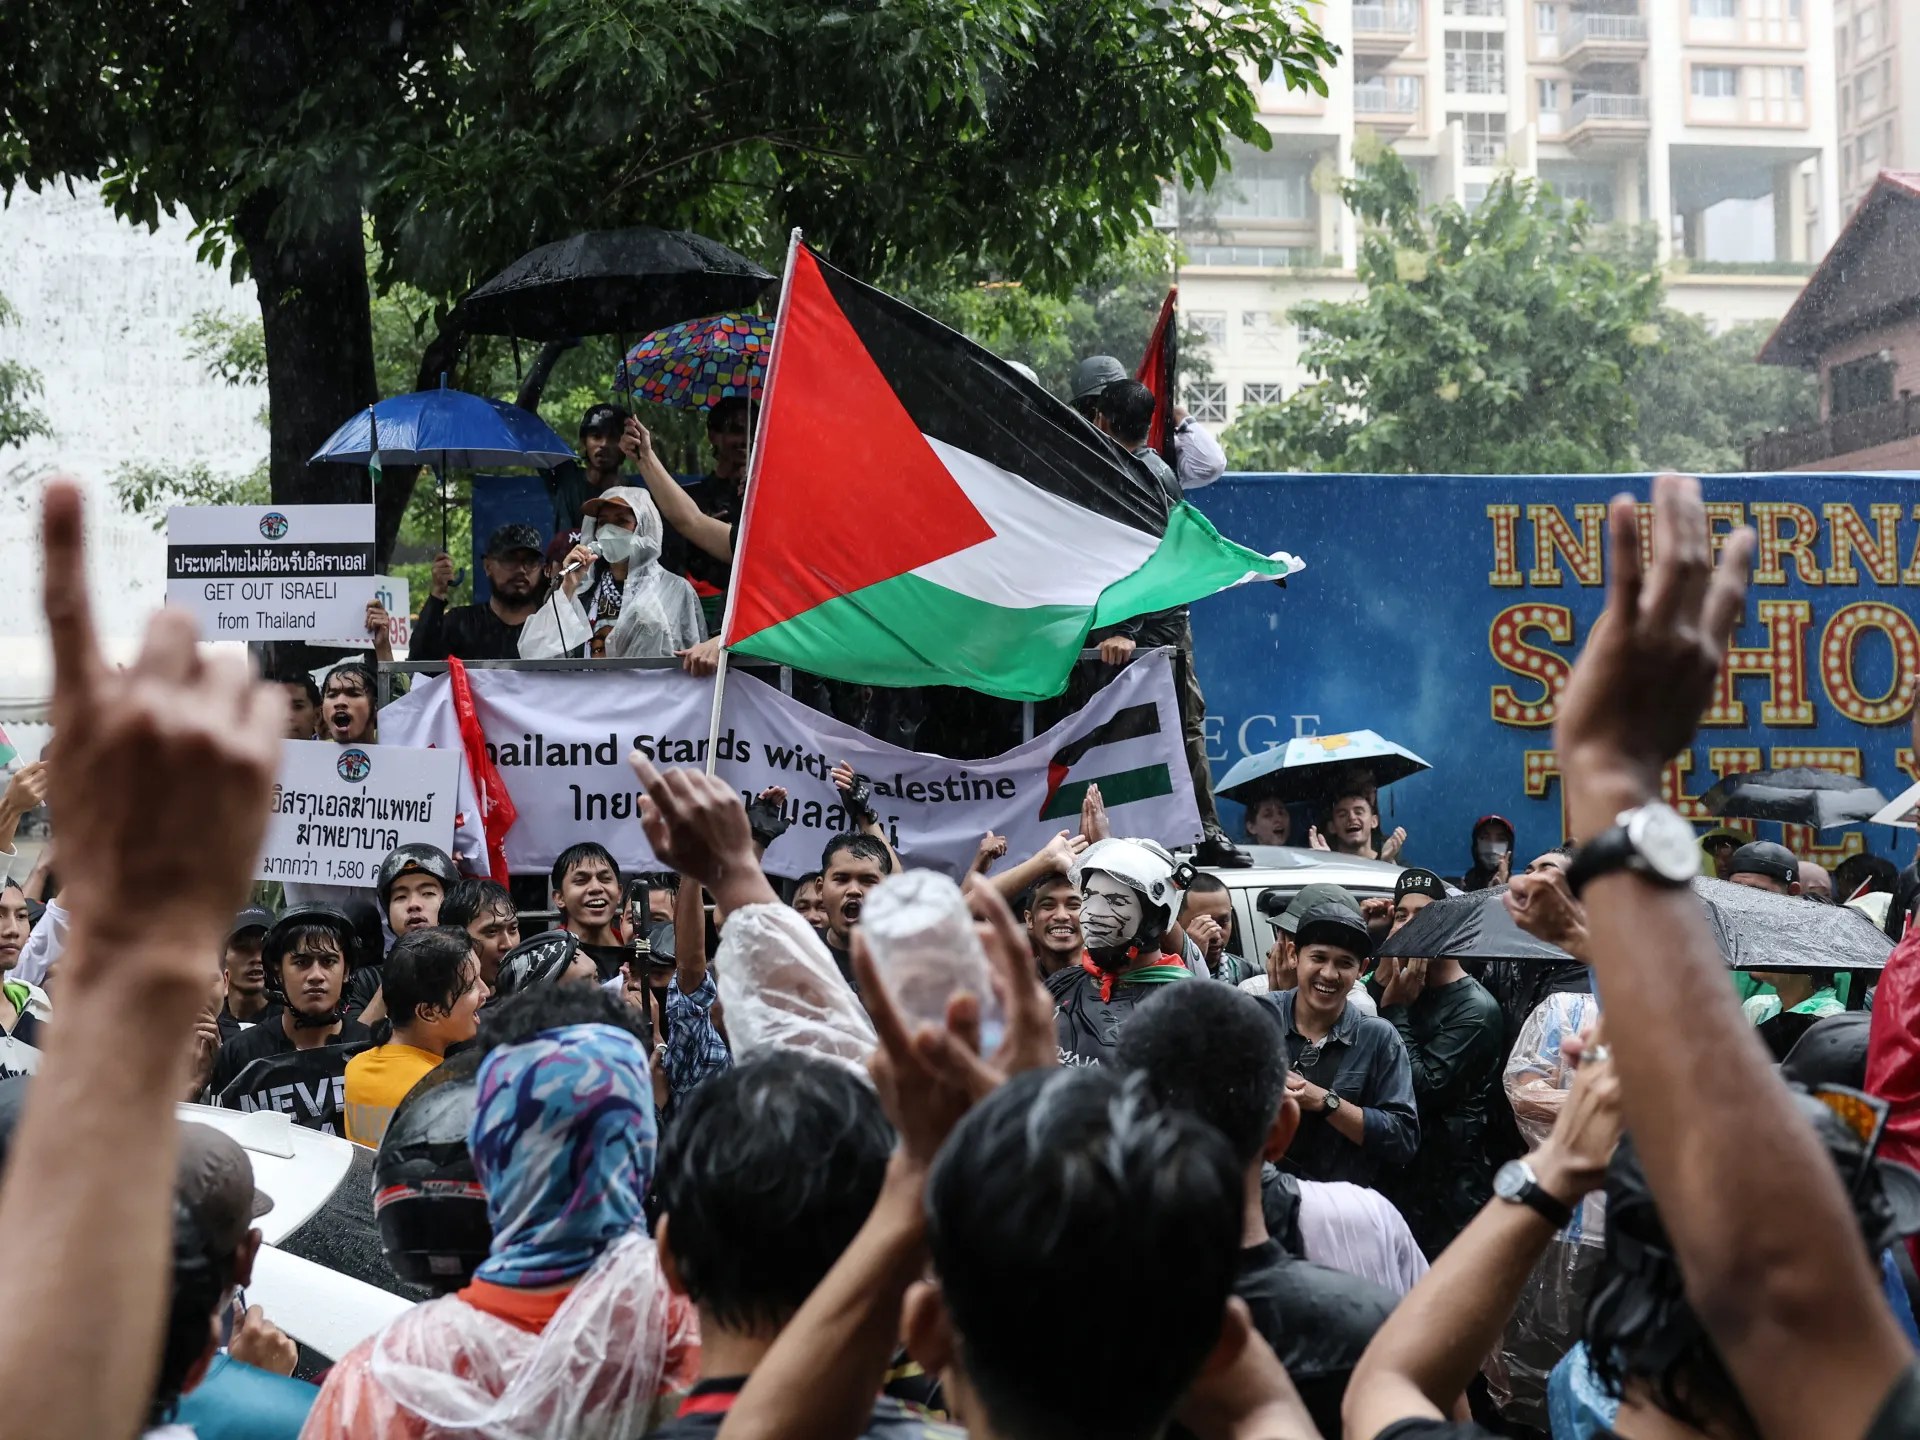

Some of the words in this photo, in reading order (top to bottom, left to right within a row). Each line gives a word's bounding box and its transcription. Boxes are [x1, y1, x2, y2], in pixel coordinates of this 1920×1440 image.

[174, 549, 367, 573] ประเทศไทยไม่ต้อนรับอิสราเอล!
[204, 583, 234, 601] GET
[241, 582, 274, 600] OUT
[281, 581, 337, 599] ISRAELI
[218, 612, 249, 629] from
[256, 611, 316, 629] Thailand
[1488, 599, 1920, 726] SHO
[633, 728, 751, 763] Stands
[272, 783, 435, 823] อิสราเอลฆ่าแพทย์
[296, 813, 399, 851] ฆ่าพยาบาล
[263, 852, 318, 876] มากกว่า
[326, 859, 365, 880] 1,580
